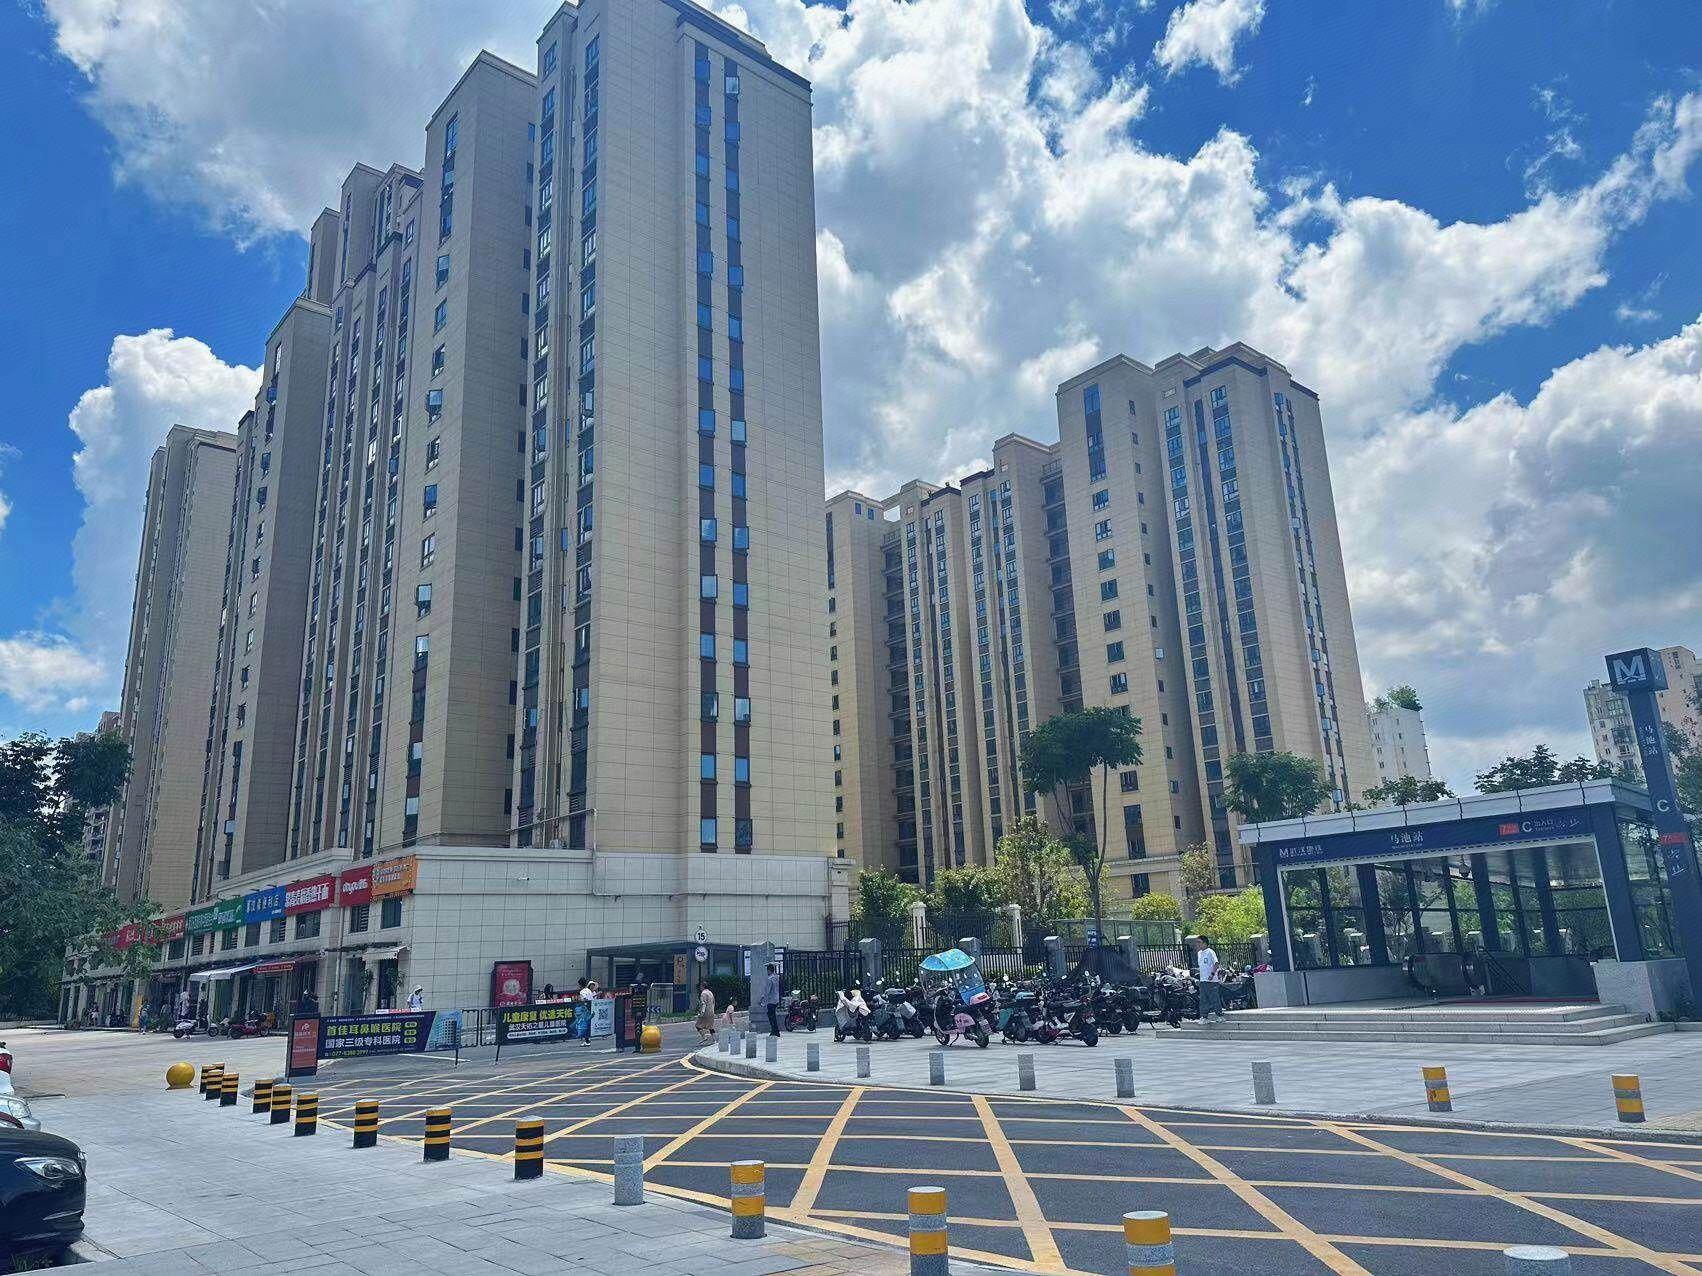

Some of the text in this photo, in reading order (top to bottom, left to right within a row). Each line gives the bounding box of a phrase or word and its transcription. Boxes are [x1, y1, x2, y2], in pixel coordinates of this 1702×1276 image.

[1657, 799, 1669, 812] C
[1522, 821, 1533, 833] C
[1390, 830, 1424, 844] 马池站
[697, 932, 706, 941] 15
[325, 1034, 401, 1049] 国家三级专科医院
